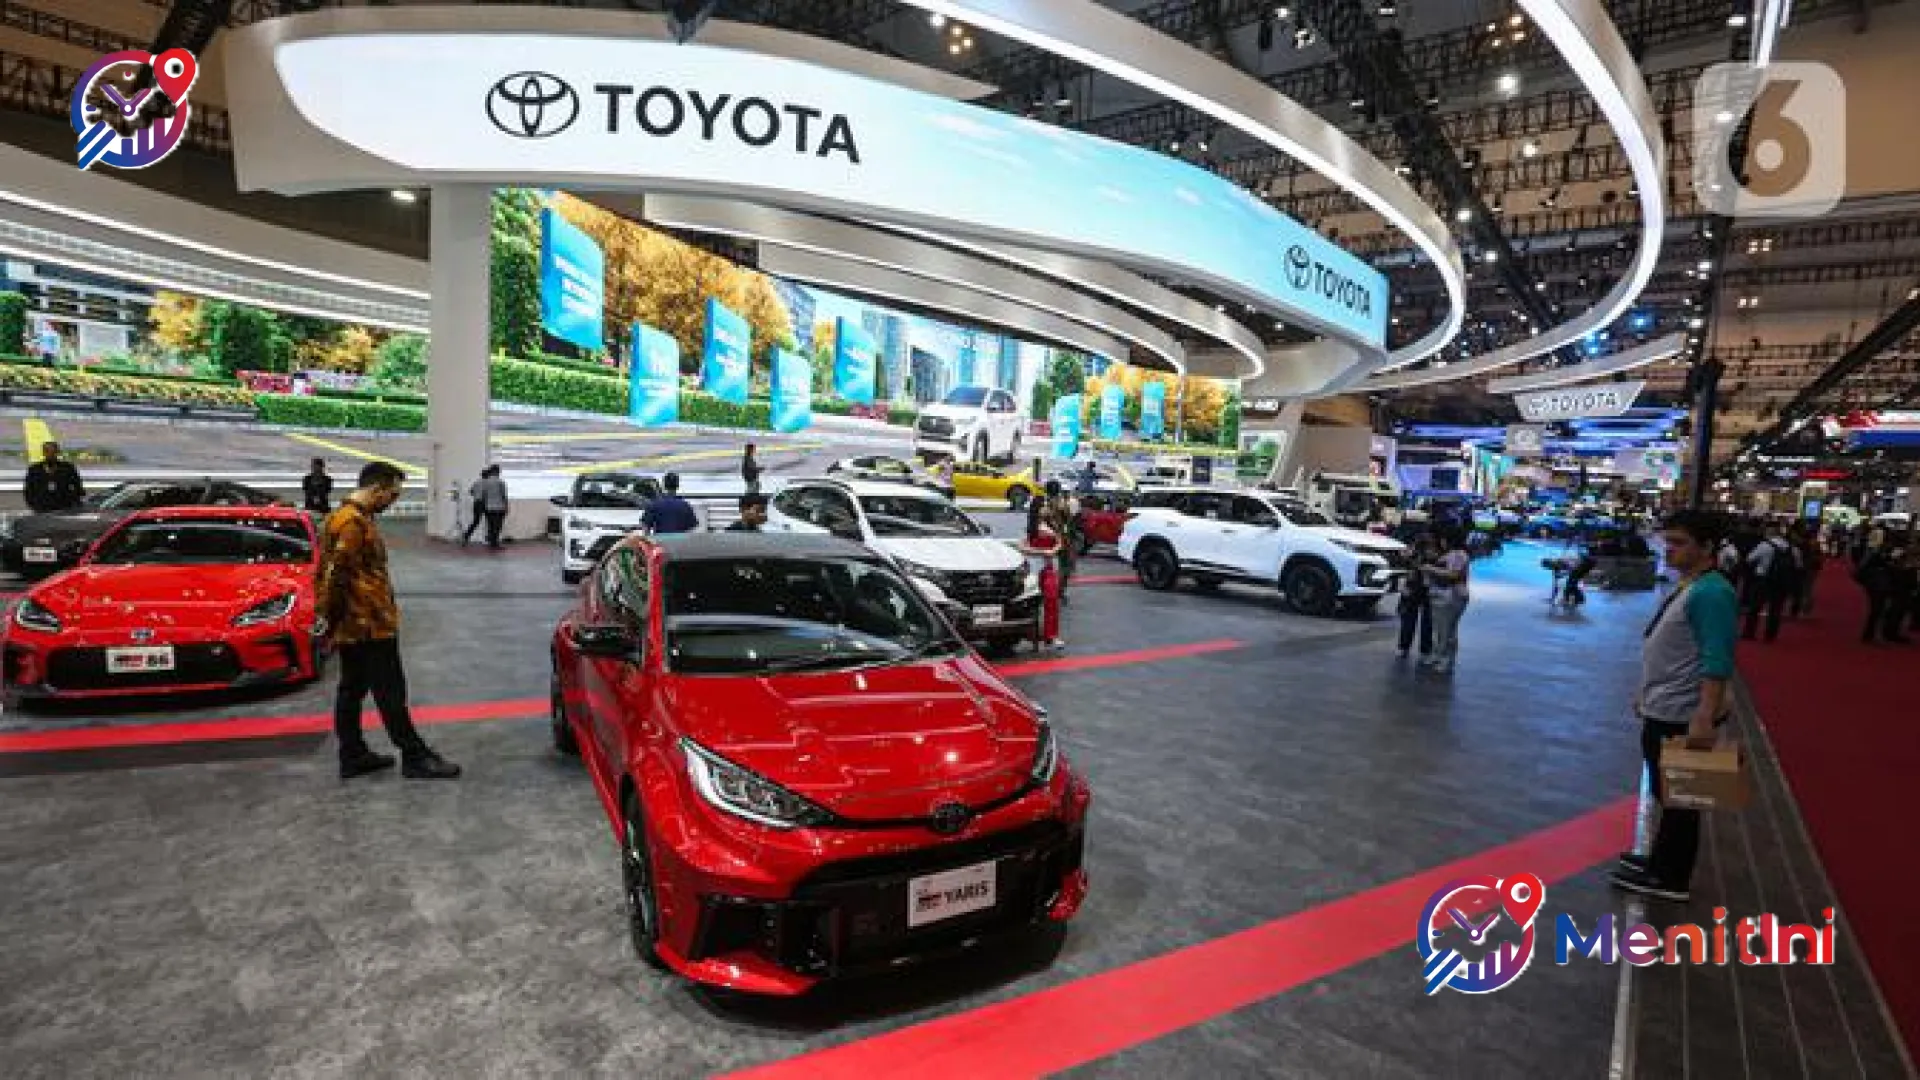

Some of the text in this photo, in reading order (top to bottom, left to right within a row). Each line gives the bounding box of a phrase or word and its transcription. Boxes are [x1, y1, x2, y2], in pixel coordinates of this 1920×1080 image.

[594, 82, 860, 164] TOYOTA
[1314, 261, 1372, 319] TOYOTA
[1550, 391, 1617, 412] TOYOTA
[943, 880, 989, 904] YARIS
